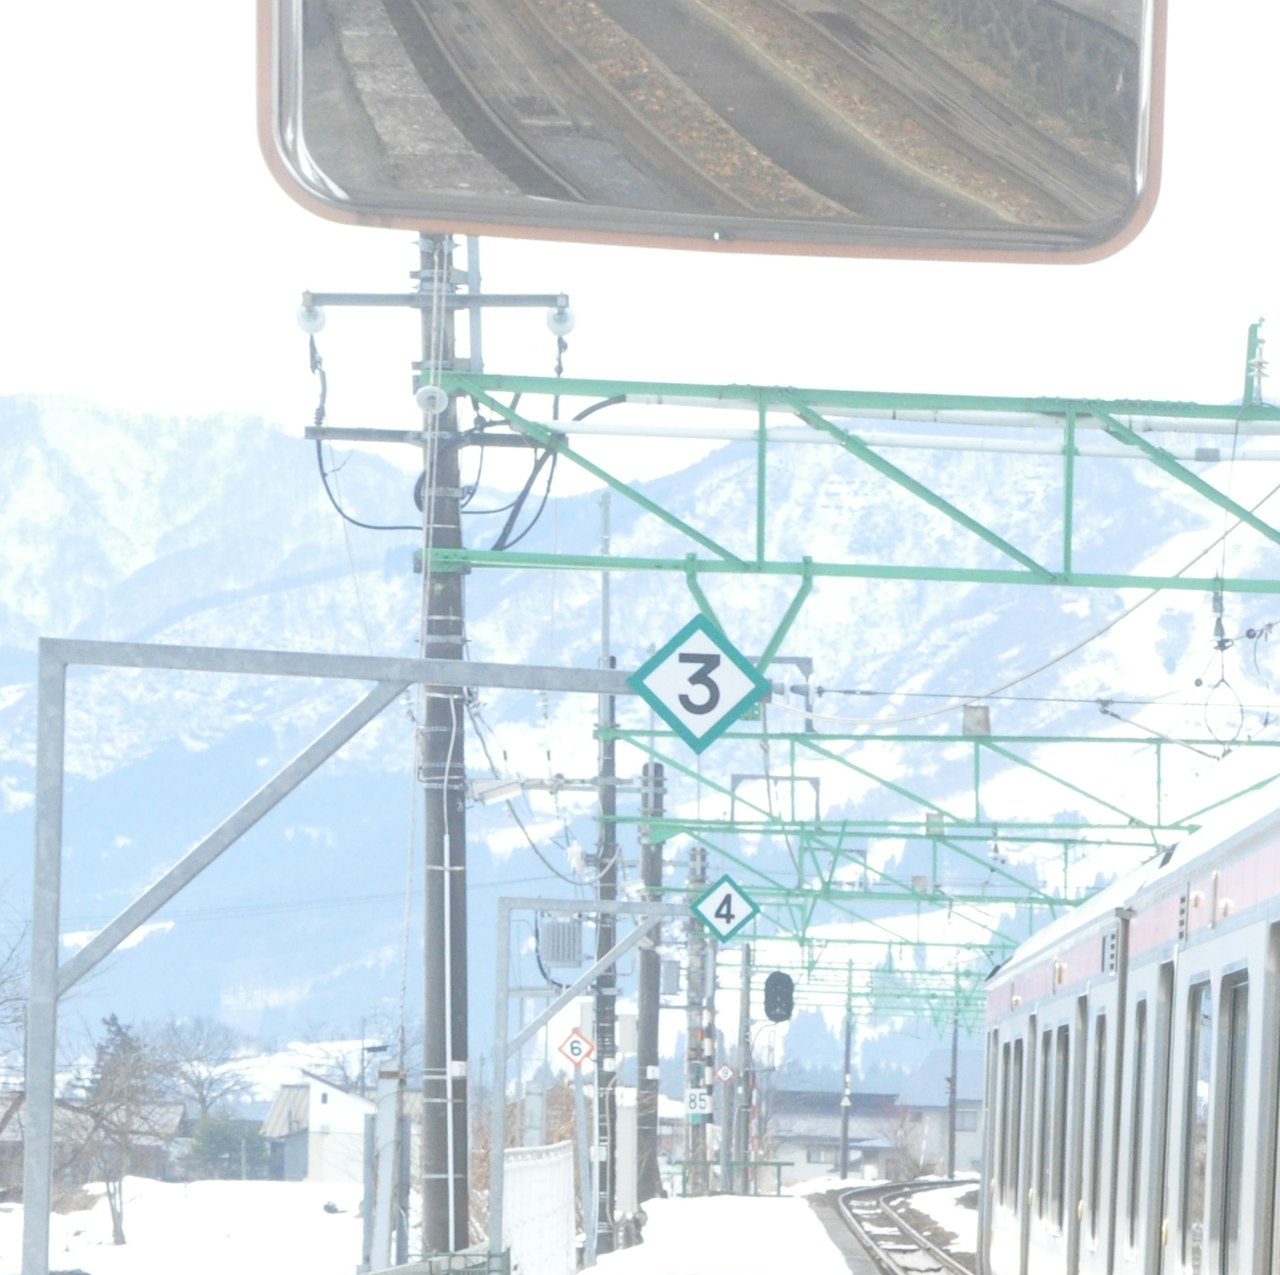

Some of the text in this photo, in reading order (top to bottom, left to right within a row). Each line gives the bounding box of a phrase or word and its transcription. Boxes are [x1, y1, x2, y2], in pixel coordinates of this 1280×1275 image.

[678, 653, 721, 715] 3
[714, 893, 735, 924] 4
[569, 1040, 582, 1056] 6
[688, 1093, 707, 1110] 85
